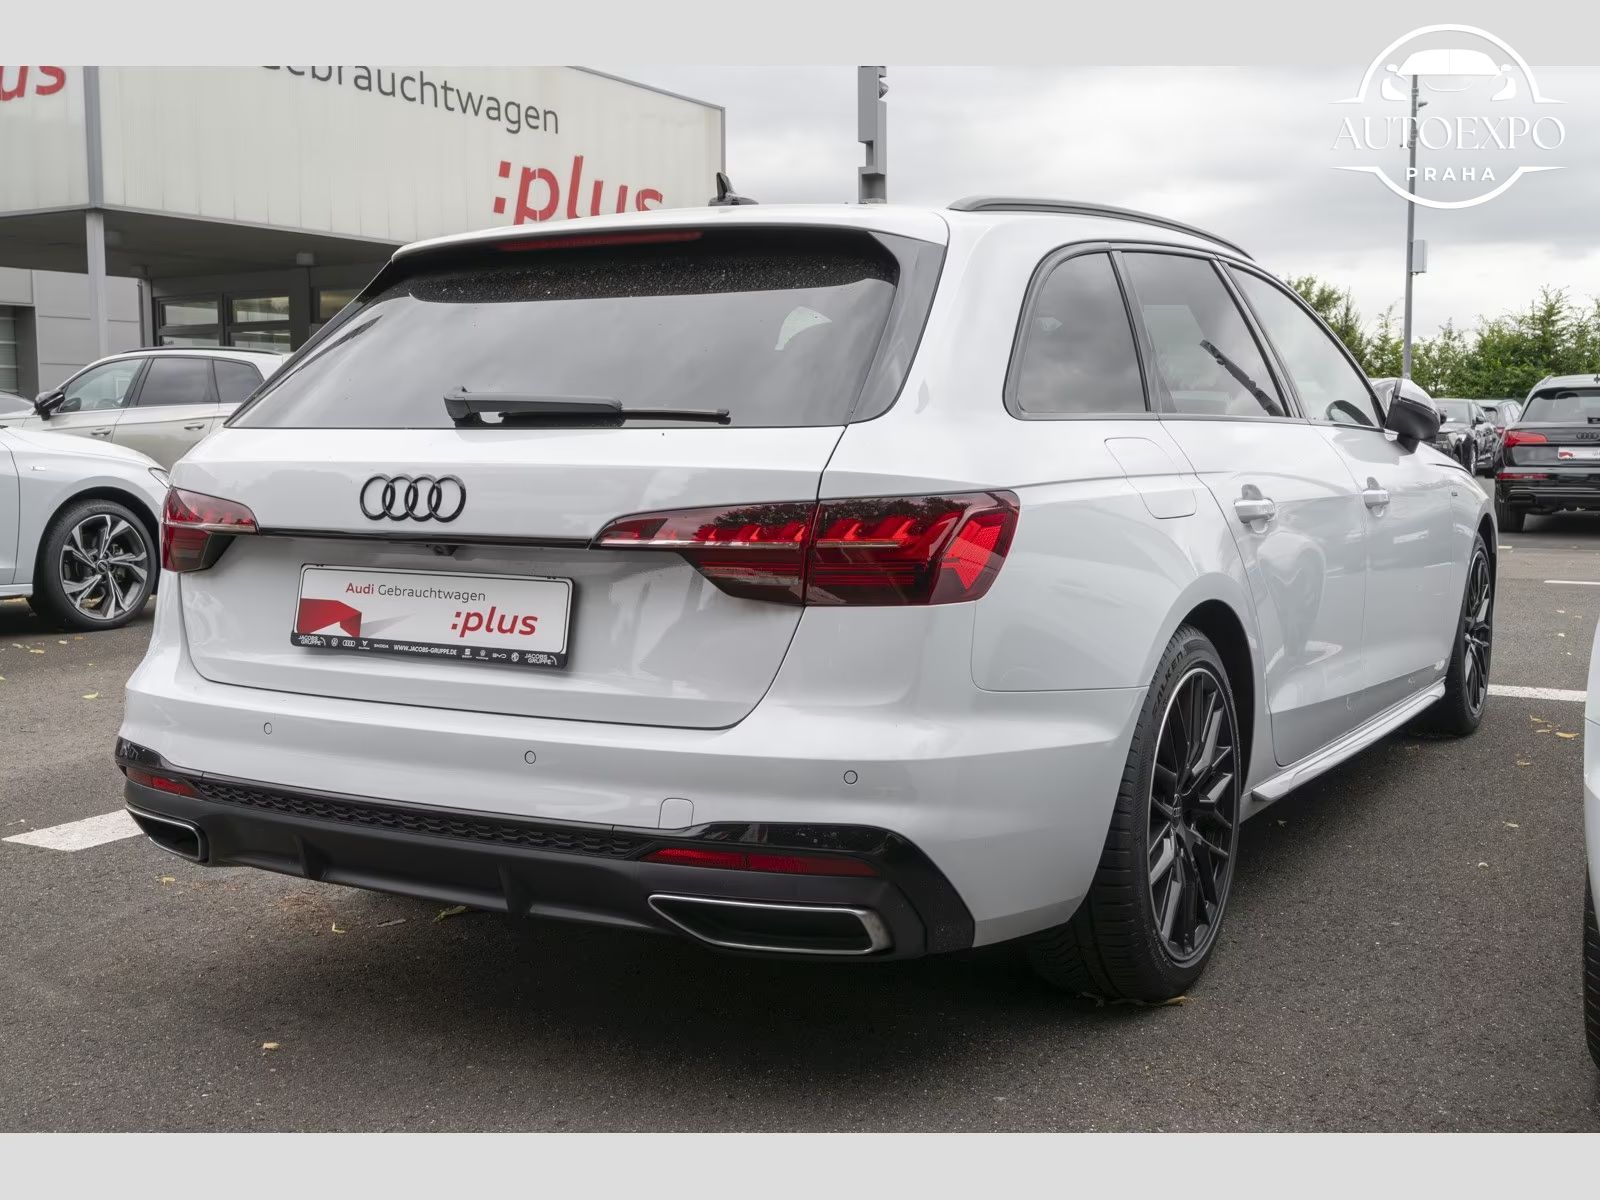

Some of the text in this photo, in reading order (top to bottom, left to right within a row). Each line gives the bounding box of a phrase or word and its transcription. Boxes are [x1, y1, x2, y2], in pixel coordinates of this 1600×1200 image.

[261, 66, 559, 135] rauchtwagen
[345, 582, 486, 604] Audi Gebrauchtwagen
[451, 606, 539, 638] :plus
